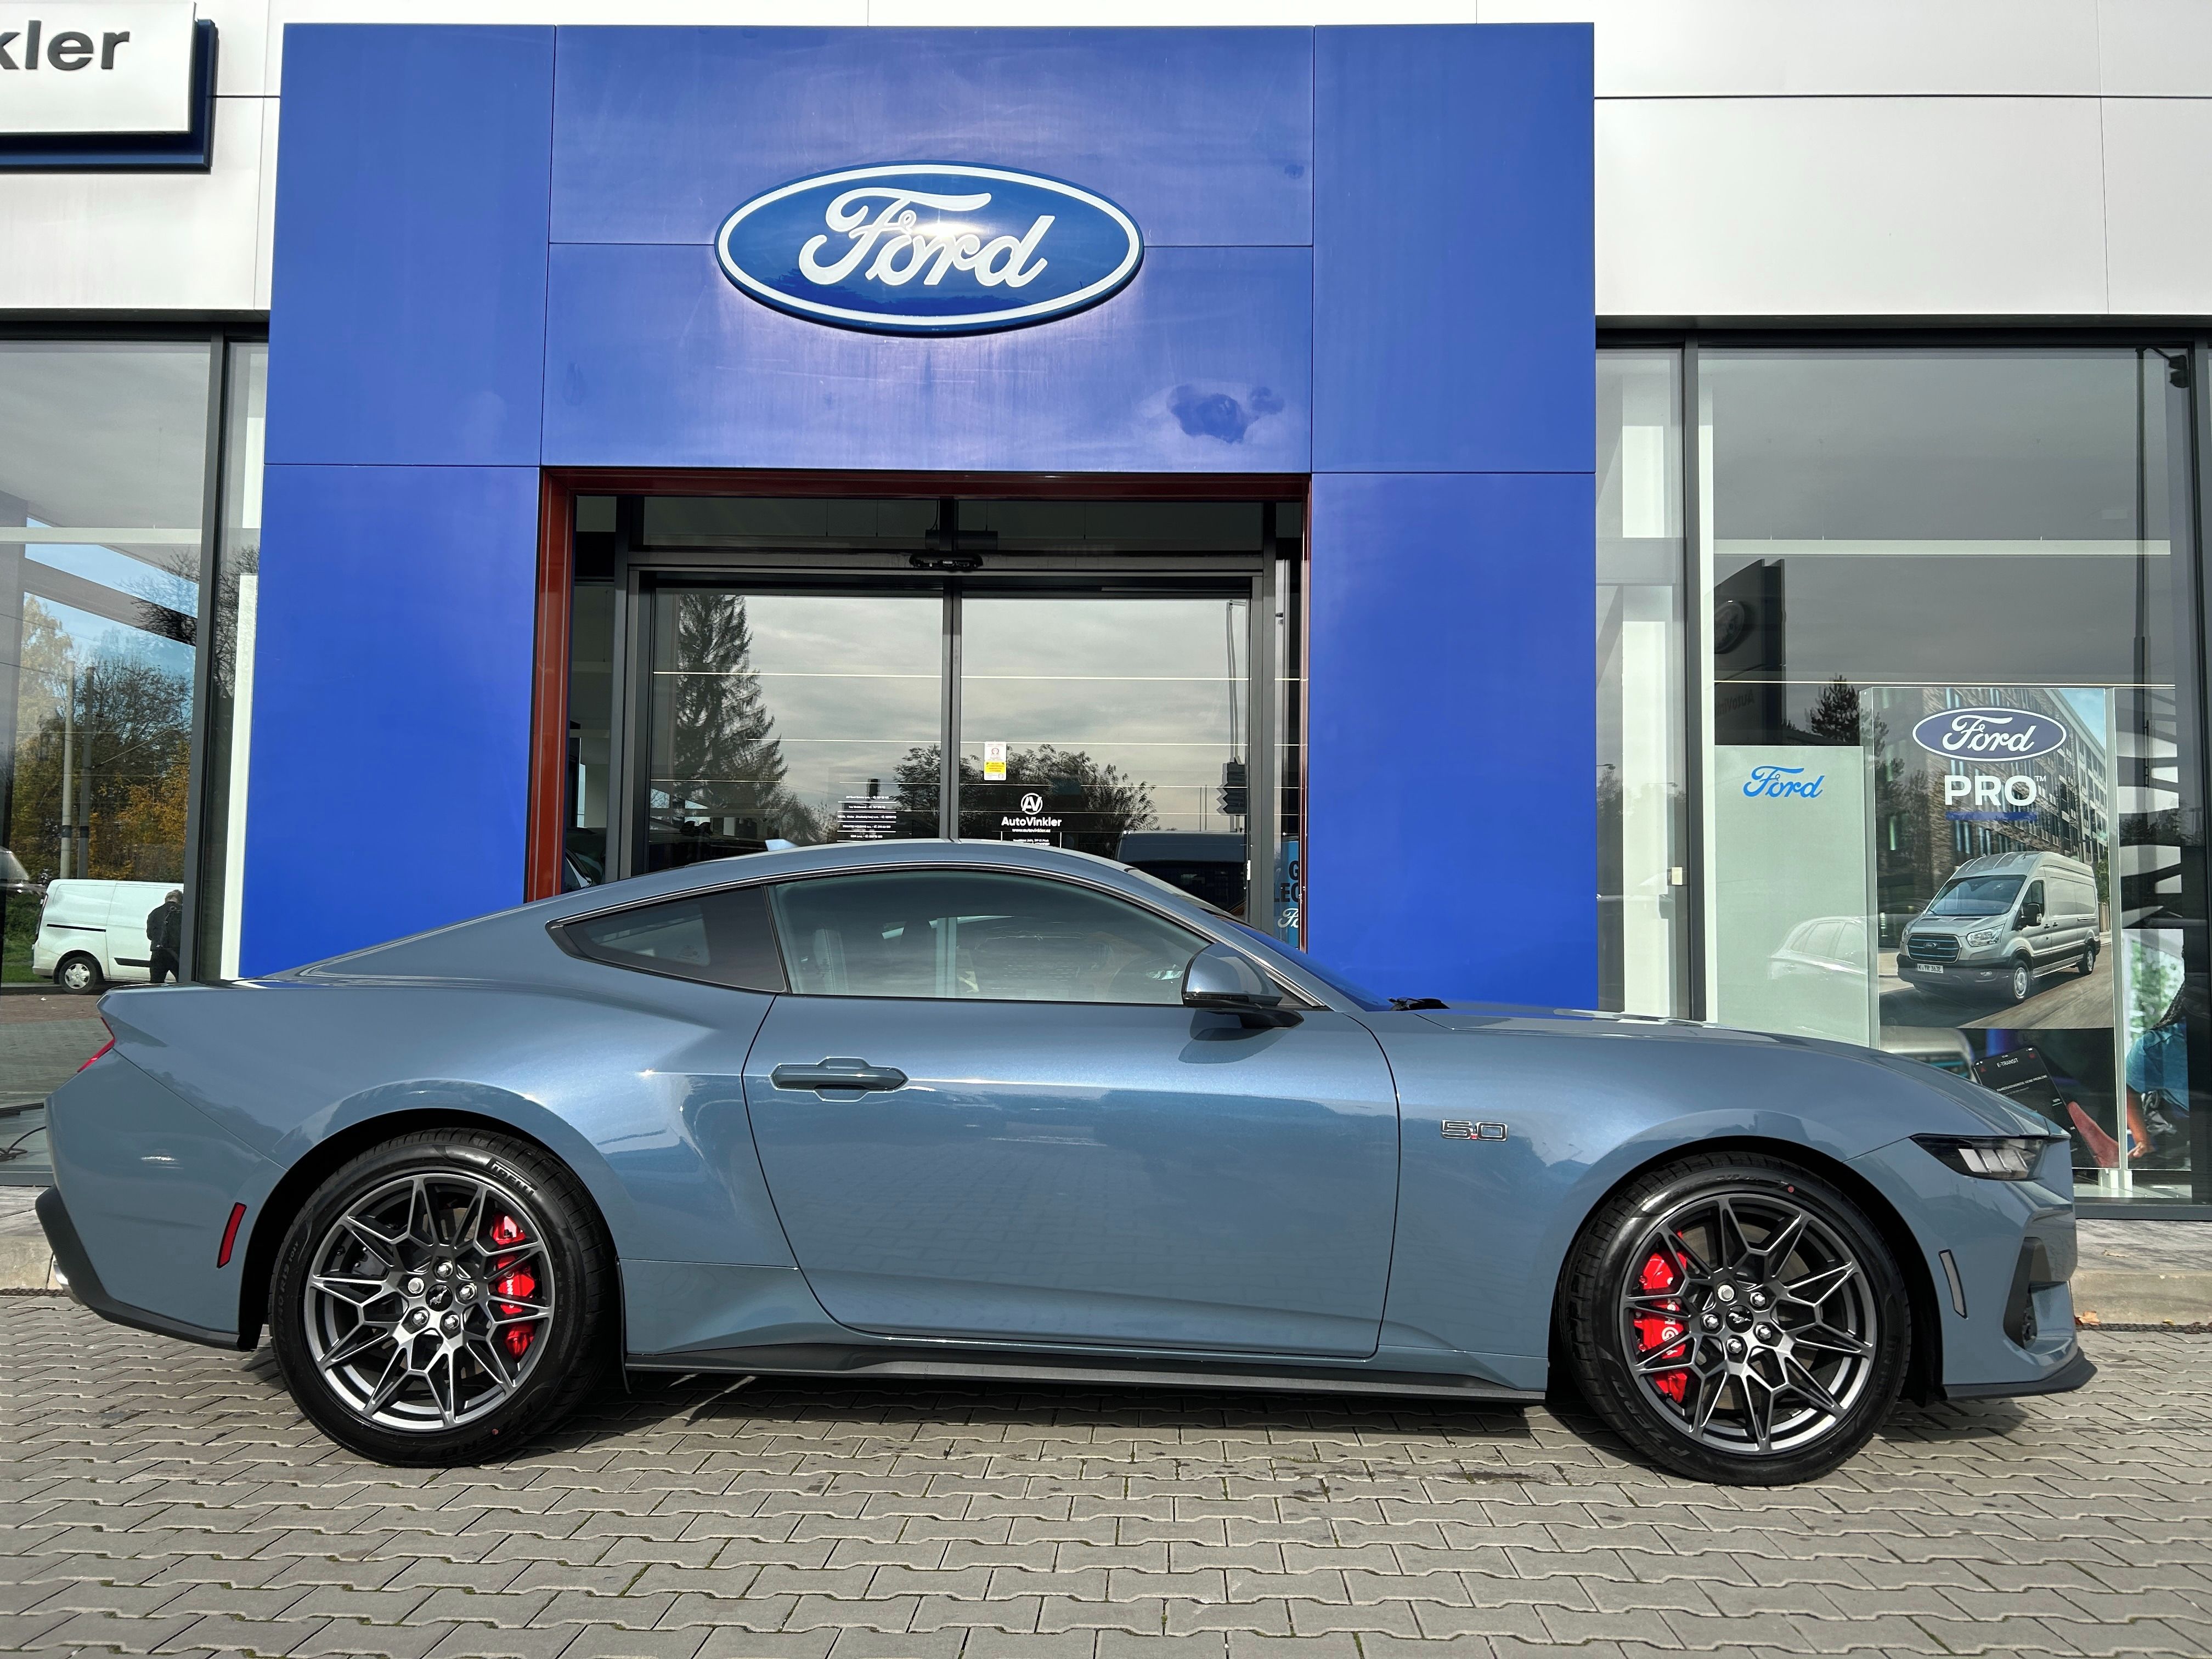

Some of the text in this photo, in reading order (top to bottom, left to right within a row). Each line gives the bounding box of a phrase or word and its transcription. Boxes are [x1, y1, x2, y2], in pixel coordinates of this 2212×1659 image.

[798, 187, 1056, 288] Ford
[1942, 714, 2037, 752] Ford
[1743, 765, 1825, 798] Ford
[1001, 816, 1062, 827] AutoVinkler
[1997, 1058, 2019, 1068] E-TRANSIT
[1441, 1119, 1508, 1142] 5.0
[485, 1157, 538, 1198] PIRELLI
